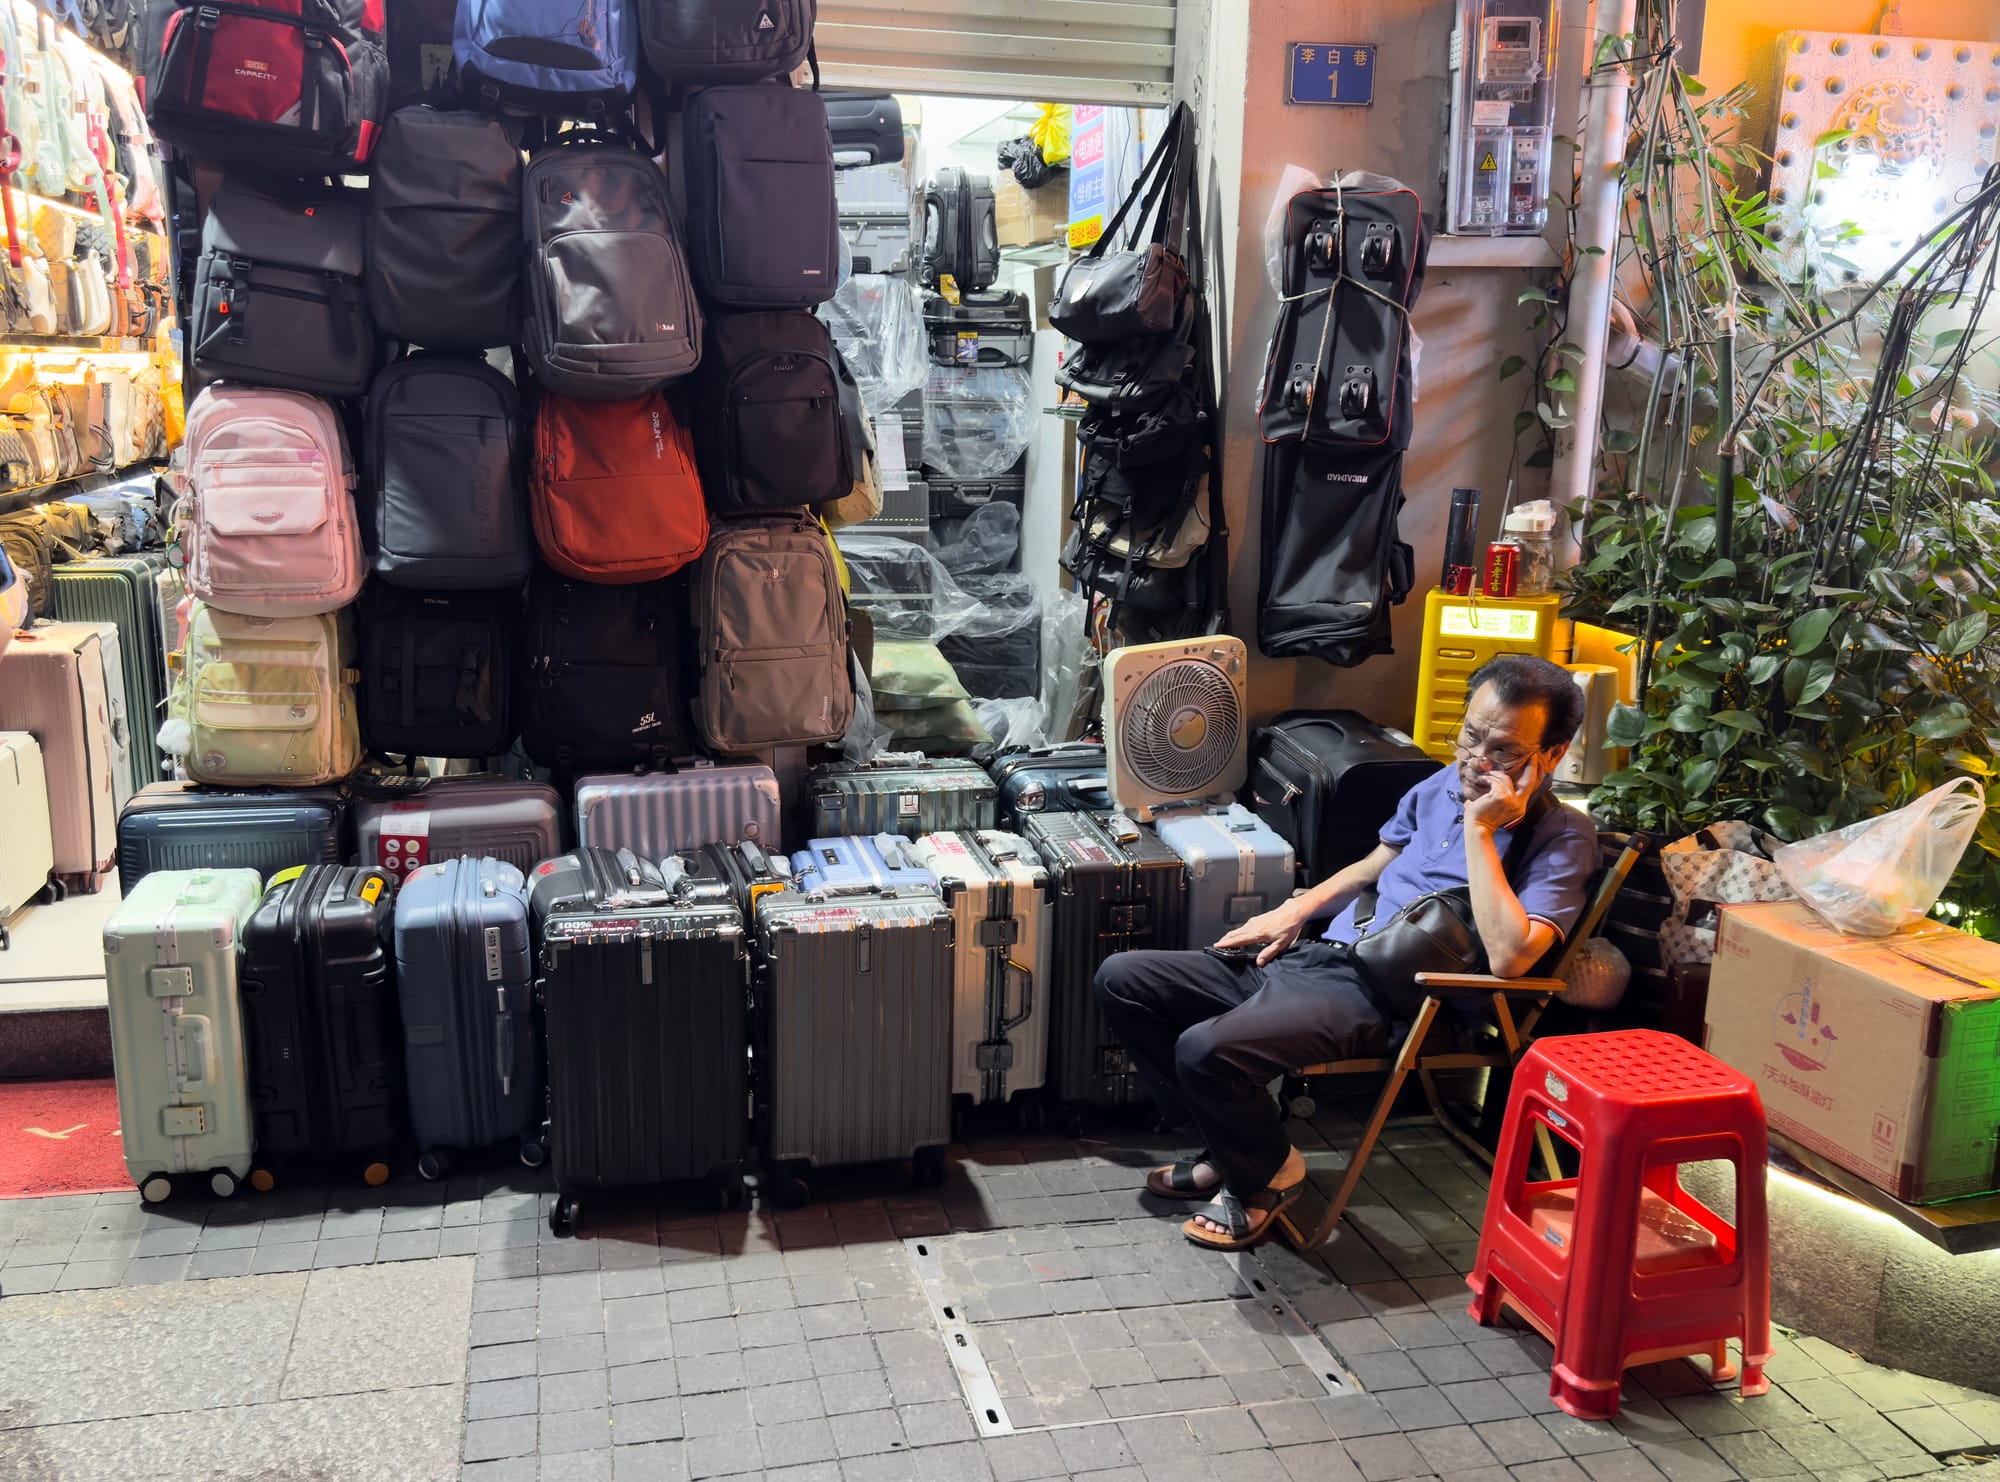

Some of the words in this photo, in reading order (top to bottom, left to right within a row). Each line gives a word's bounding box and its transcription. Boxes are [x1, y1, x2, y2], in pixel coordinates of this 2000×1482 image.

[1301, 48, 1368, 66] 李白巷
[234, 68, 278, 81] CAPACITY
[1327, 70, 1339, 99] 1
[1490, 554, 1504, 593] 王老吉
[639, 711, 656, 727] 55L
